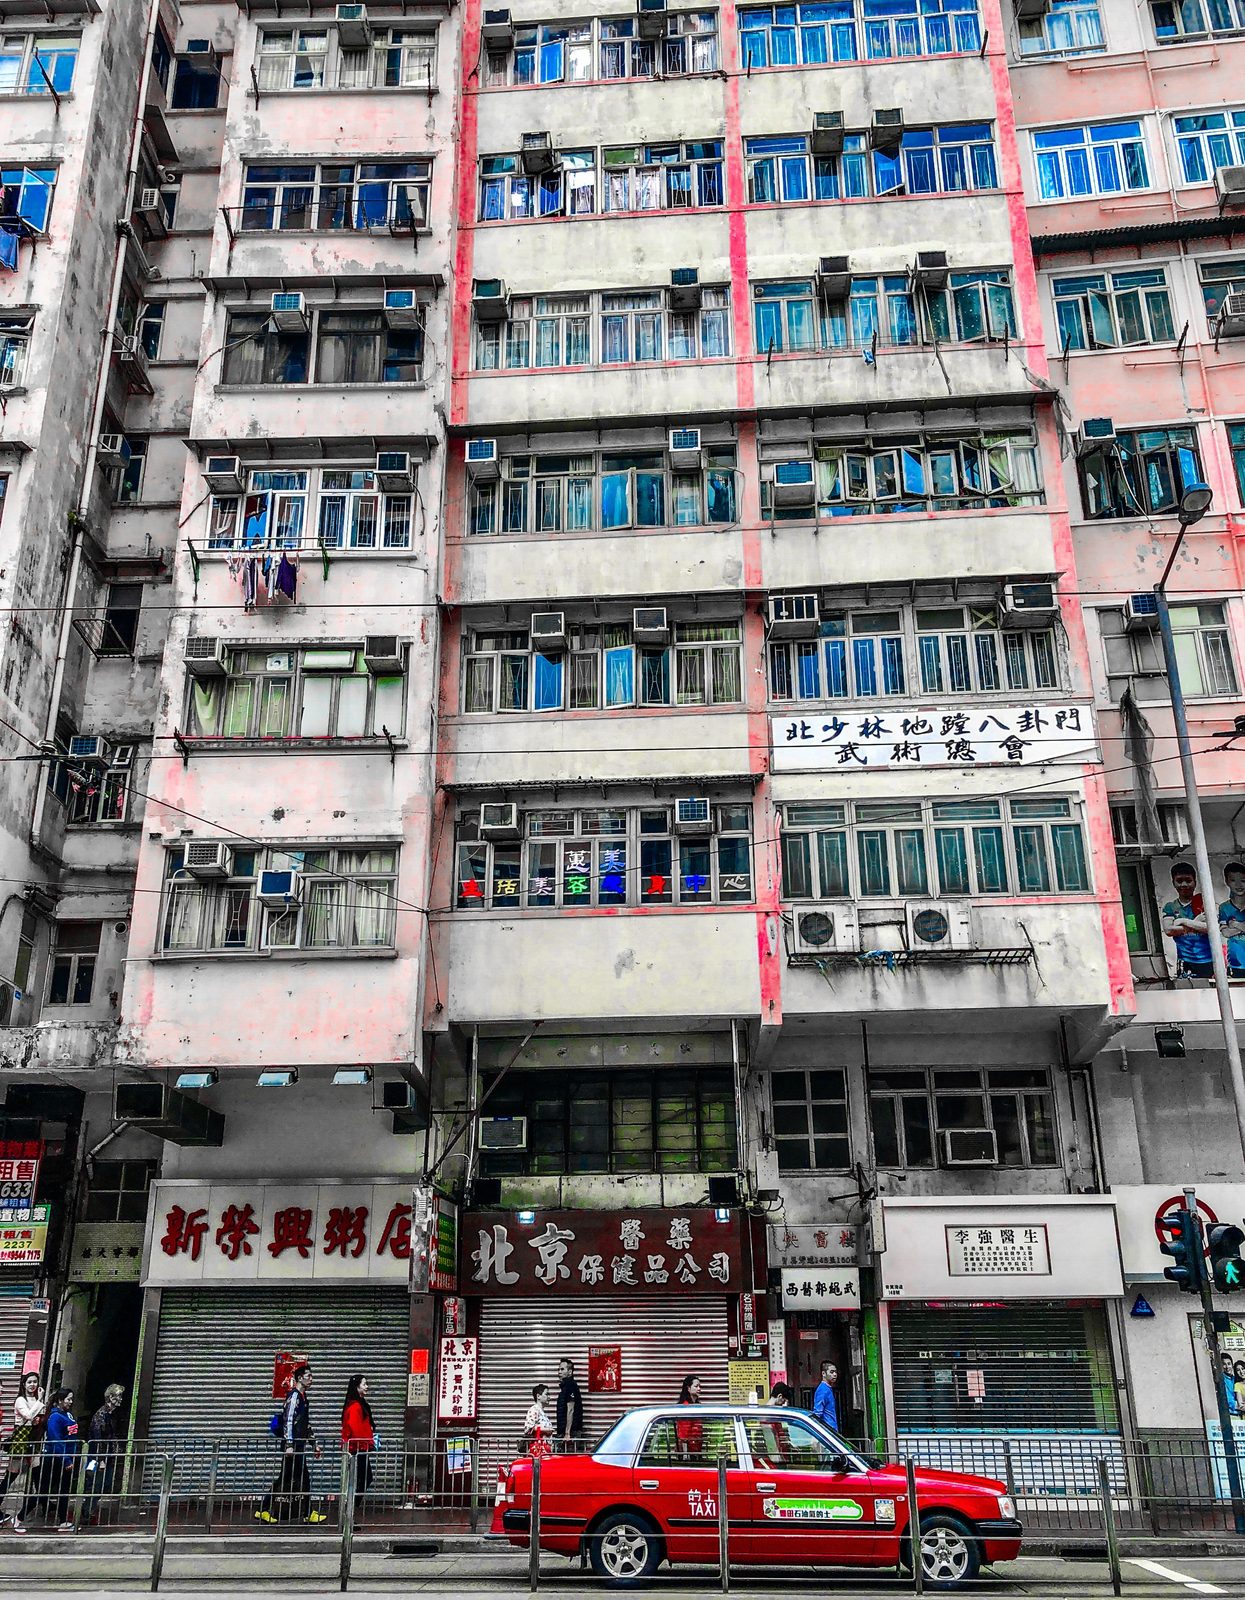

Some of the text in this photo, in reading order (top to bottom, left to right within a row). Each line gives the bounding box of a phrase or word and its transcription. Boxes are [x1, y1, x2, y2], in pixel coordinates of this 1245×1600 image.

[835, 735, 1032, 765] 武術總會
[161, 1204, 412, 1262] 新榮興粥店
[954, 1229, 1039, 1244] 李強醫生
[471, 1223, 576, 1285] 北京
[578, 1252, 730, 1285] 保健品公司
[443, 1339, 474, 1356] 北京
[688, 1502, 716, 1517] TAXI
